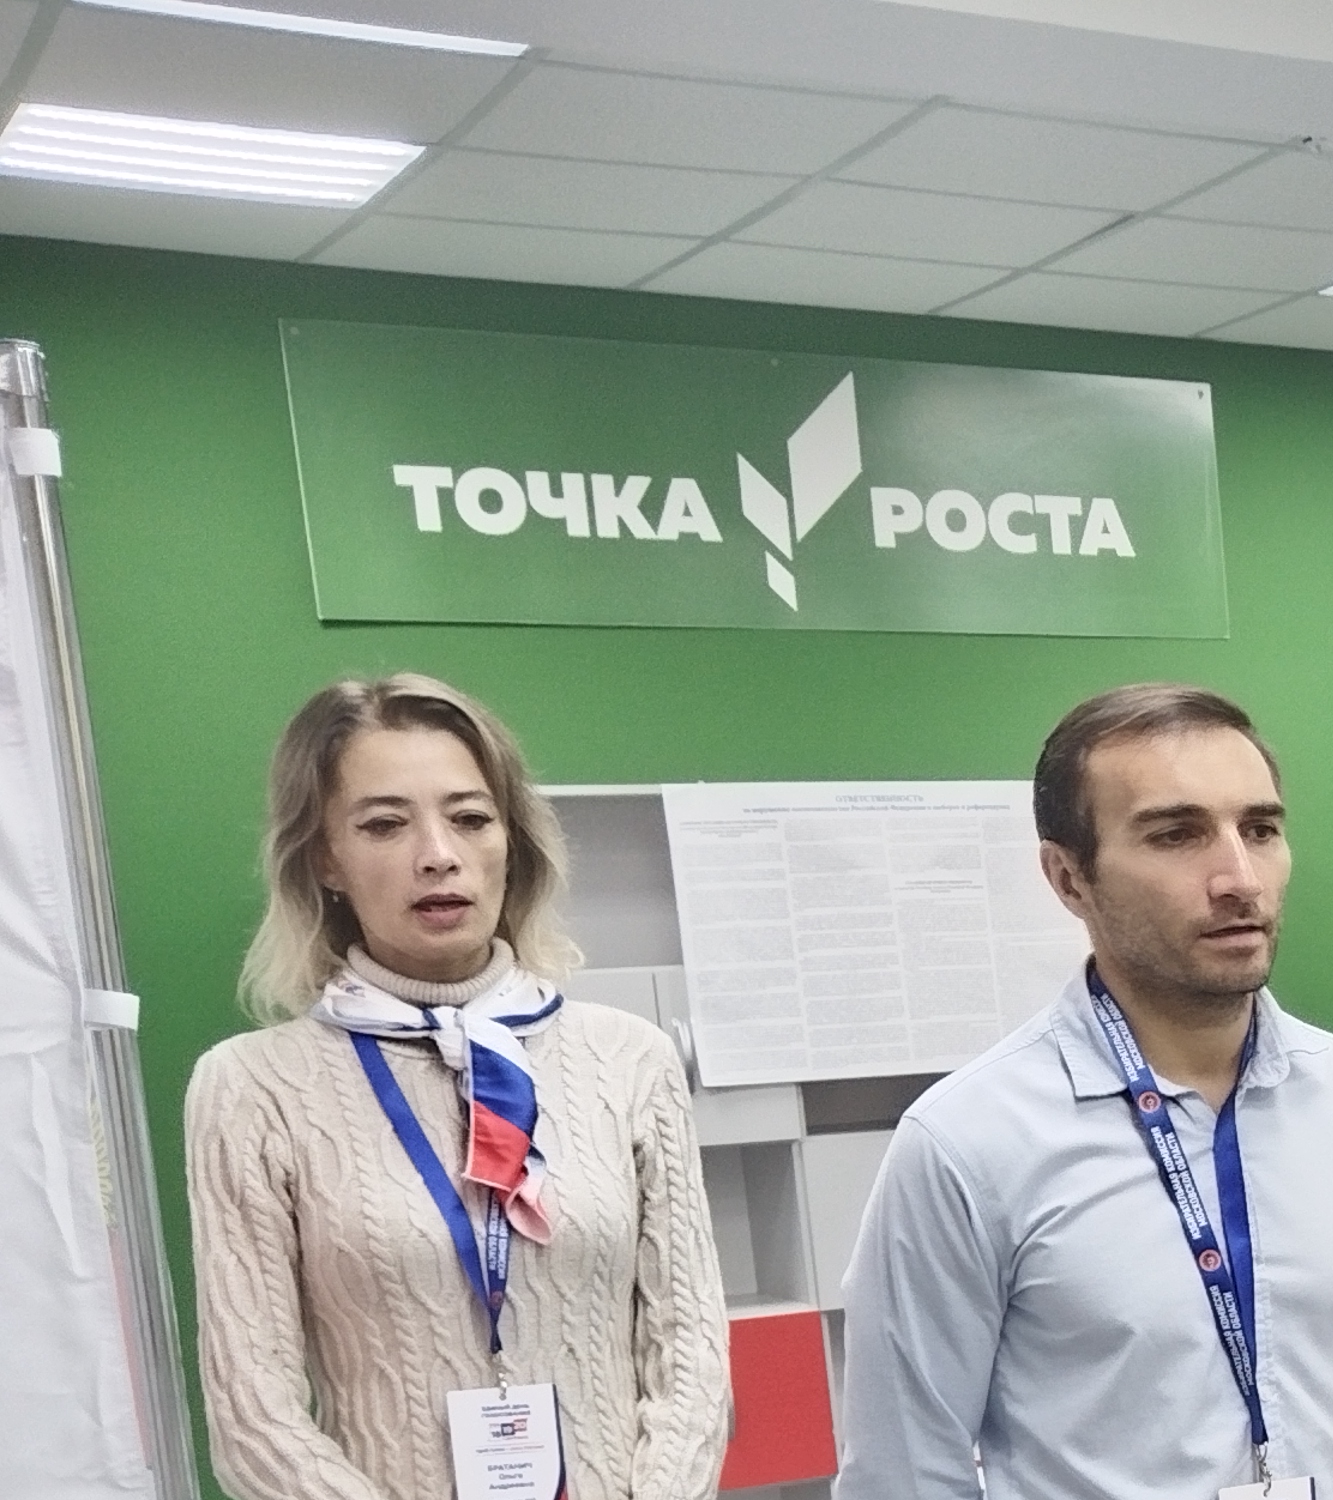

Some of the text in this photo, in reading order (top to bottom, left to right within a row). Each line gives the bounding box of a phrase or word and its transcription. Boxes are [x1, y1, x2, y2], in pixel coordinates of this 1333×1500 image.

[392, 464, 1136, 558] ТОЧКА РОСТА
[1149, 1124, 1176, 1173] КОМИССИЯ
[1164, 1131, 1208, 1227] МОСКОВСКОЙ ОБЛАСТИ
